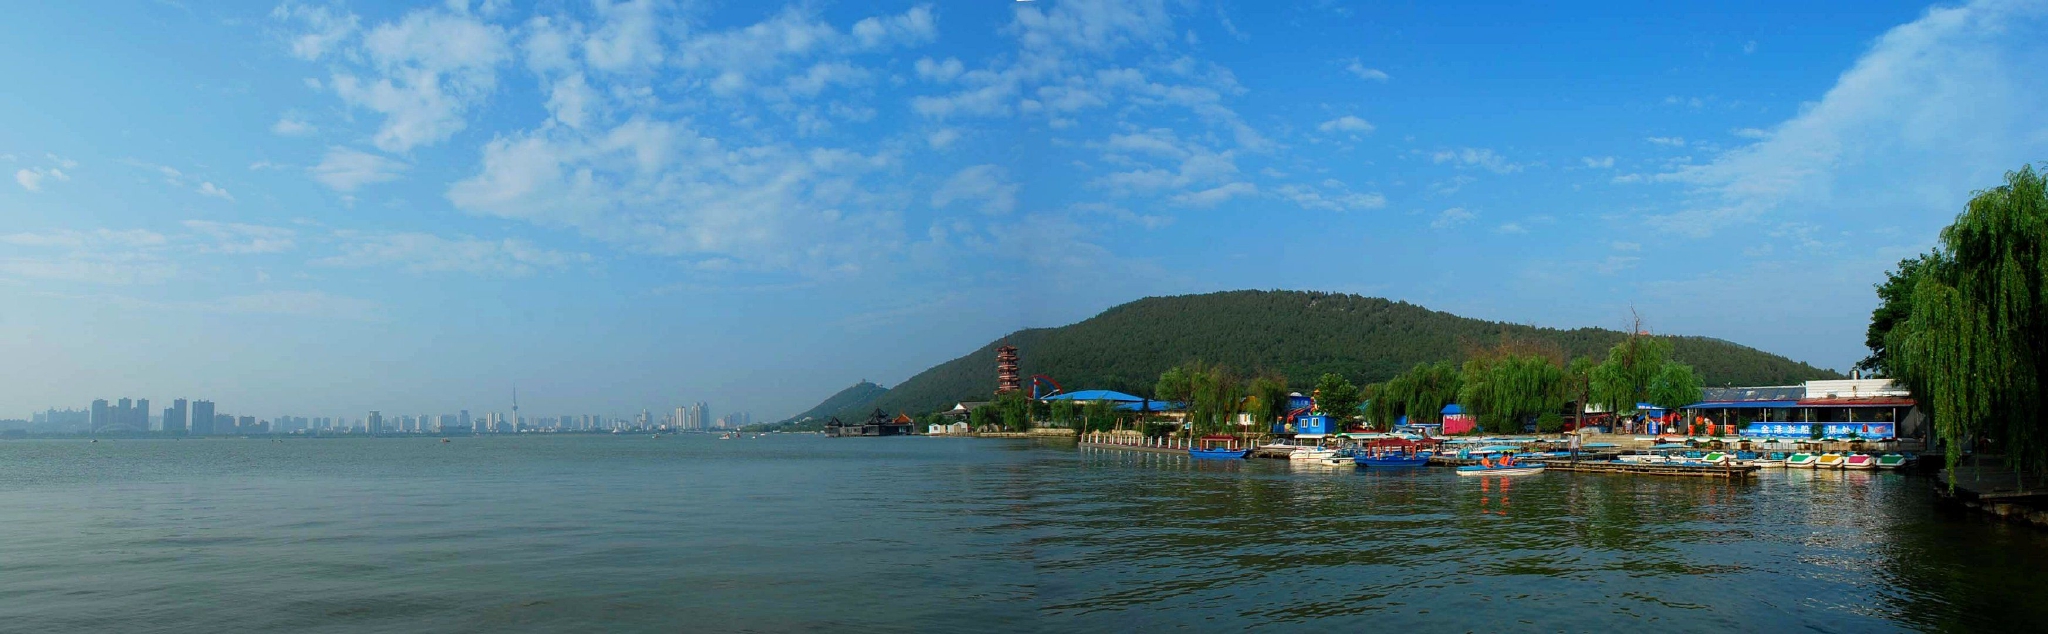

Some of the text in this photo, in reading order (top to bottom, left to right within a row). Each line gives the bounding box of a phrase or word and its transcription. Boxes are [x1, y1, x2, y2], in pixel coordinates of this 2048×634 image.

[1760, 424, 1850, 435] 金港游船票处
